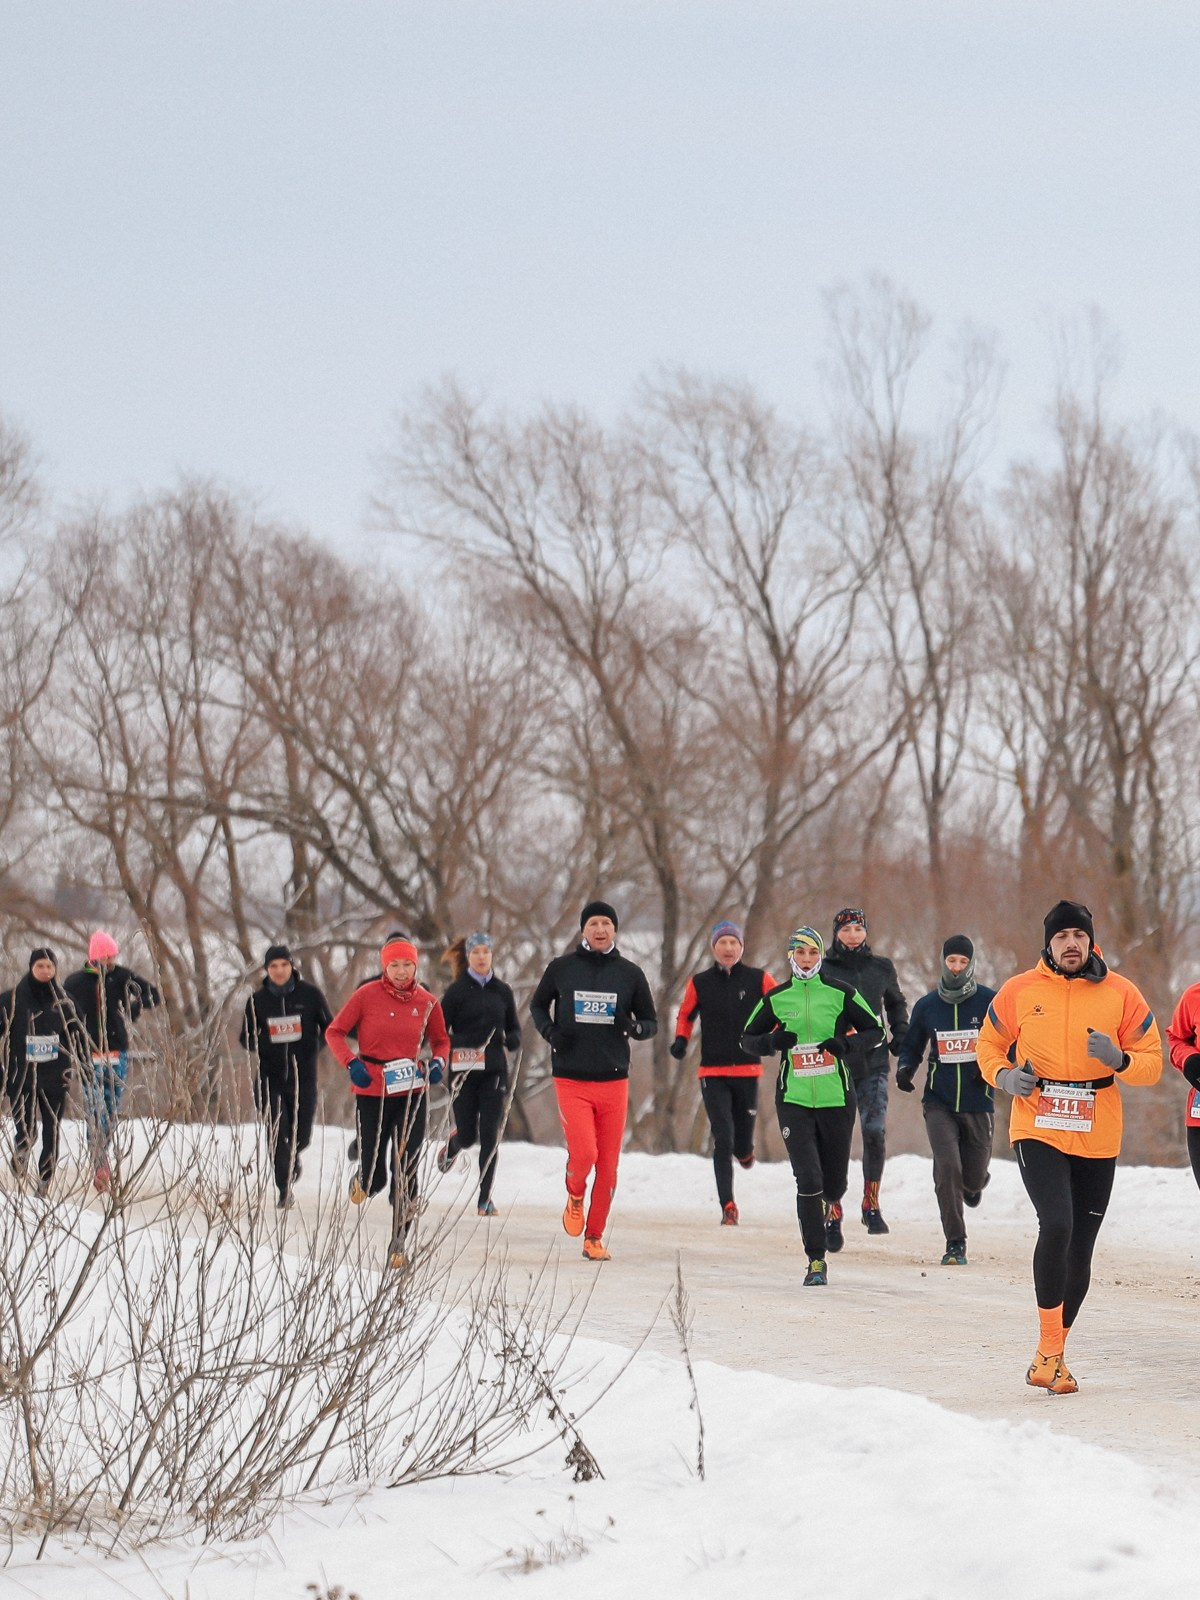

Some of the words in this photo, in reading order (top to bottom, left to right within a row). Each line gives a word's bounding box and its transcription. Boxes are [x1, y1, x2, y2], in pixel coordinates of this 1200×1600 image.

[583, 1001, 608, 1013] 282
[33, 1044, 54, 1055] 204
[946, 1039, 970, 1052] 047
[801, 1053, 825, 1066] 114
[1051, 1098, 1080, 1115] 111
